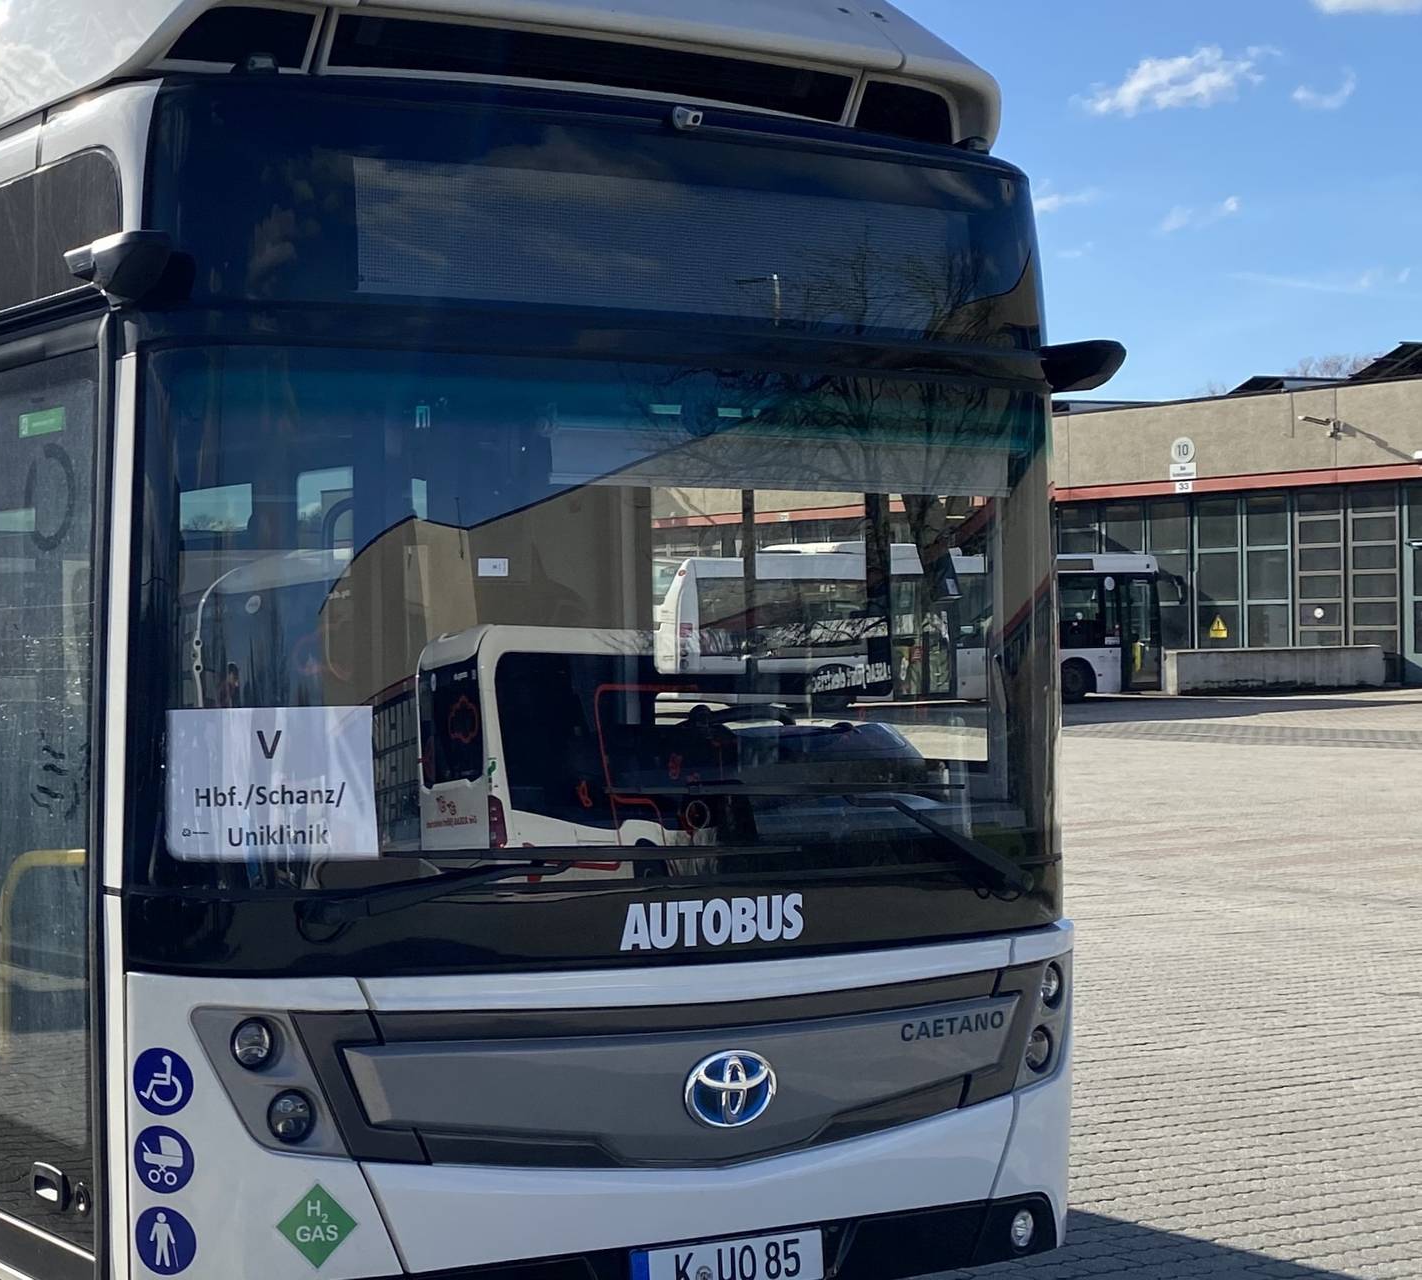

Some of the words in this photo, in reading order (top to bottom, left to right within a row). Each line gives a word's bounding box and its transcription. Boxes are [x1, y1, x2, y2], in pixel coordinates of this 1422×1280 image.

[1177, 444, 1189, 457] 10
[1178, 482, 1189, 491] 33
[256, 730, 282, 759] V
[194, 782, 346, 810] Hbf./Schanz/
[228, 822, 329, 847] Uniklinik
[619, 892, 805, 951] AUTOBUS
[900, 1010, 1005, 1042] CAETANO
[295, 1224, 339, 1242] GAS
[674, 1252, 694, 1280] K
[717, 1245, 757, 1280] UO
[765, 1238, 801, 1280] 85
